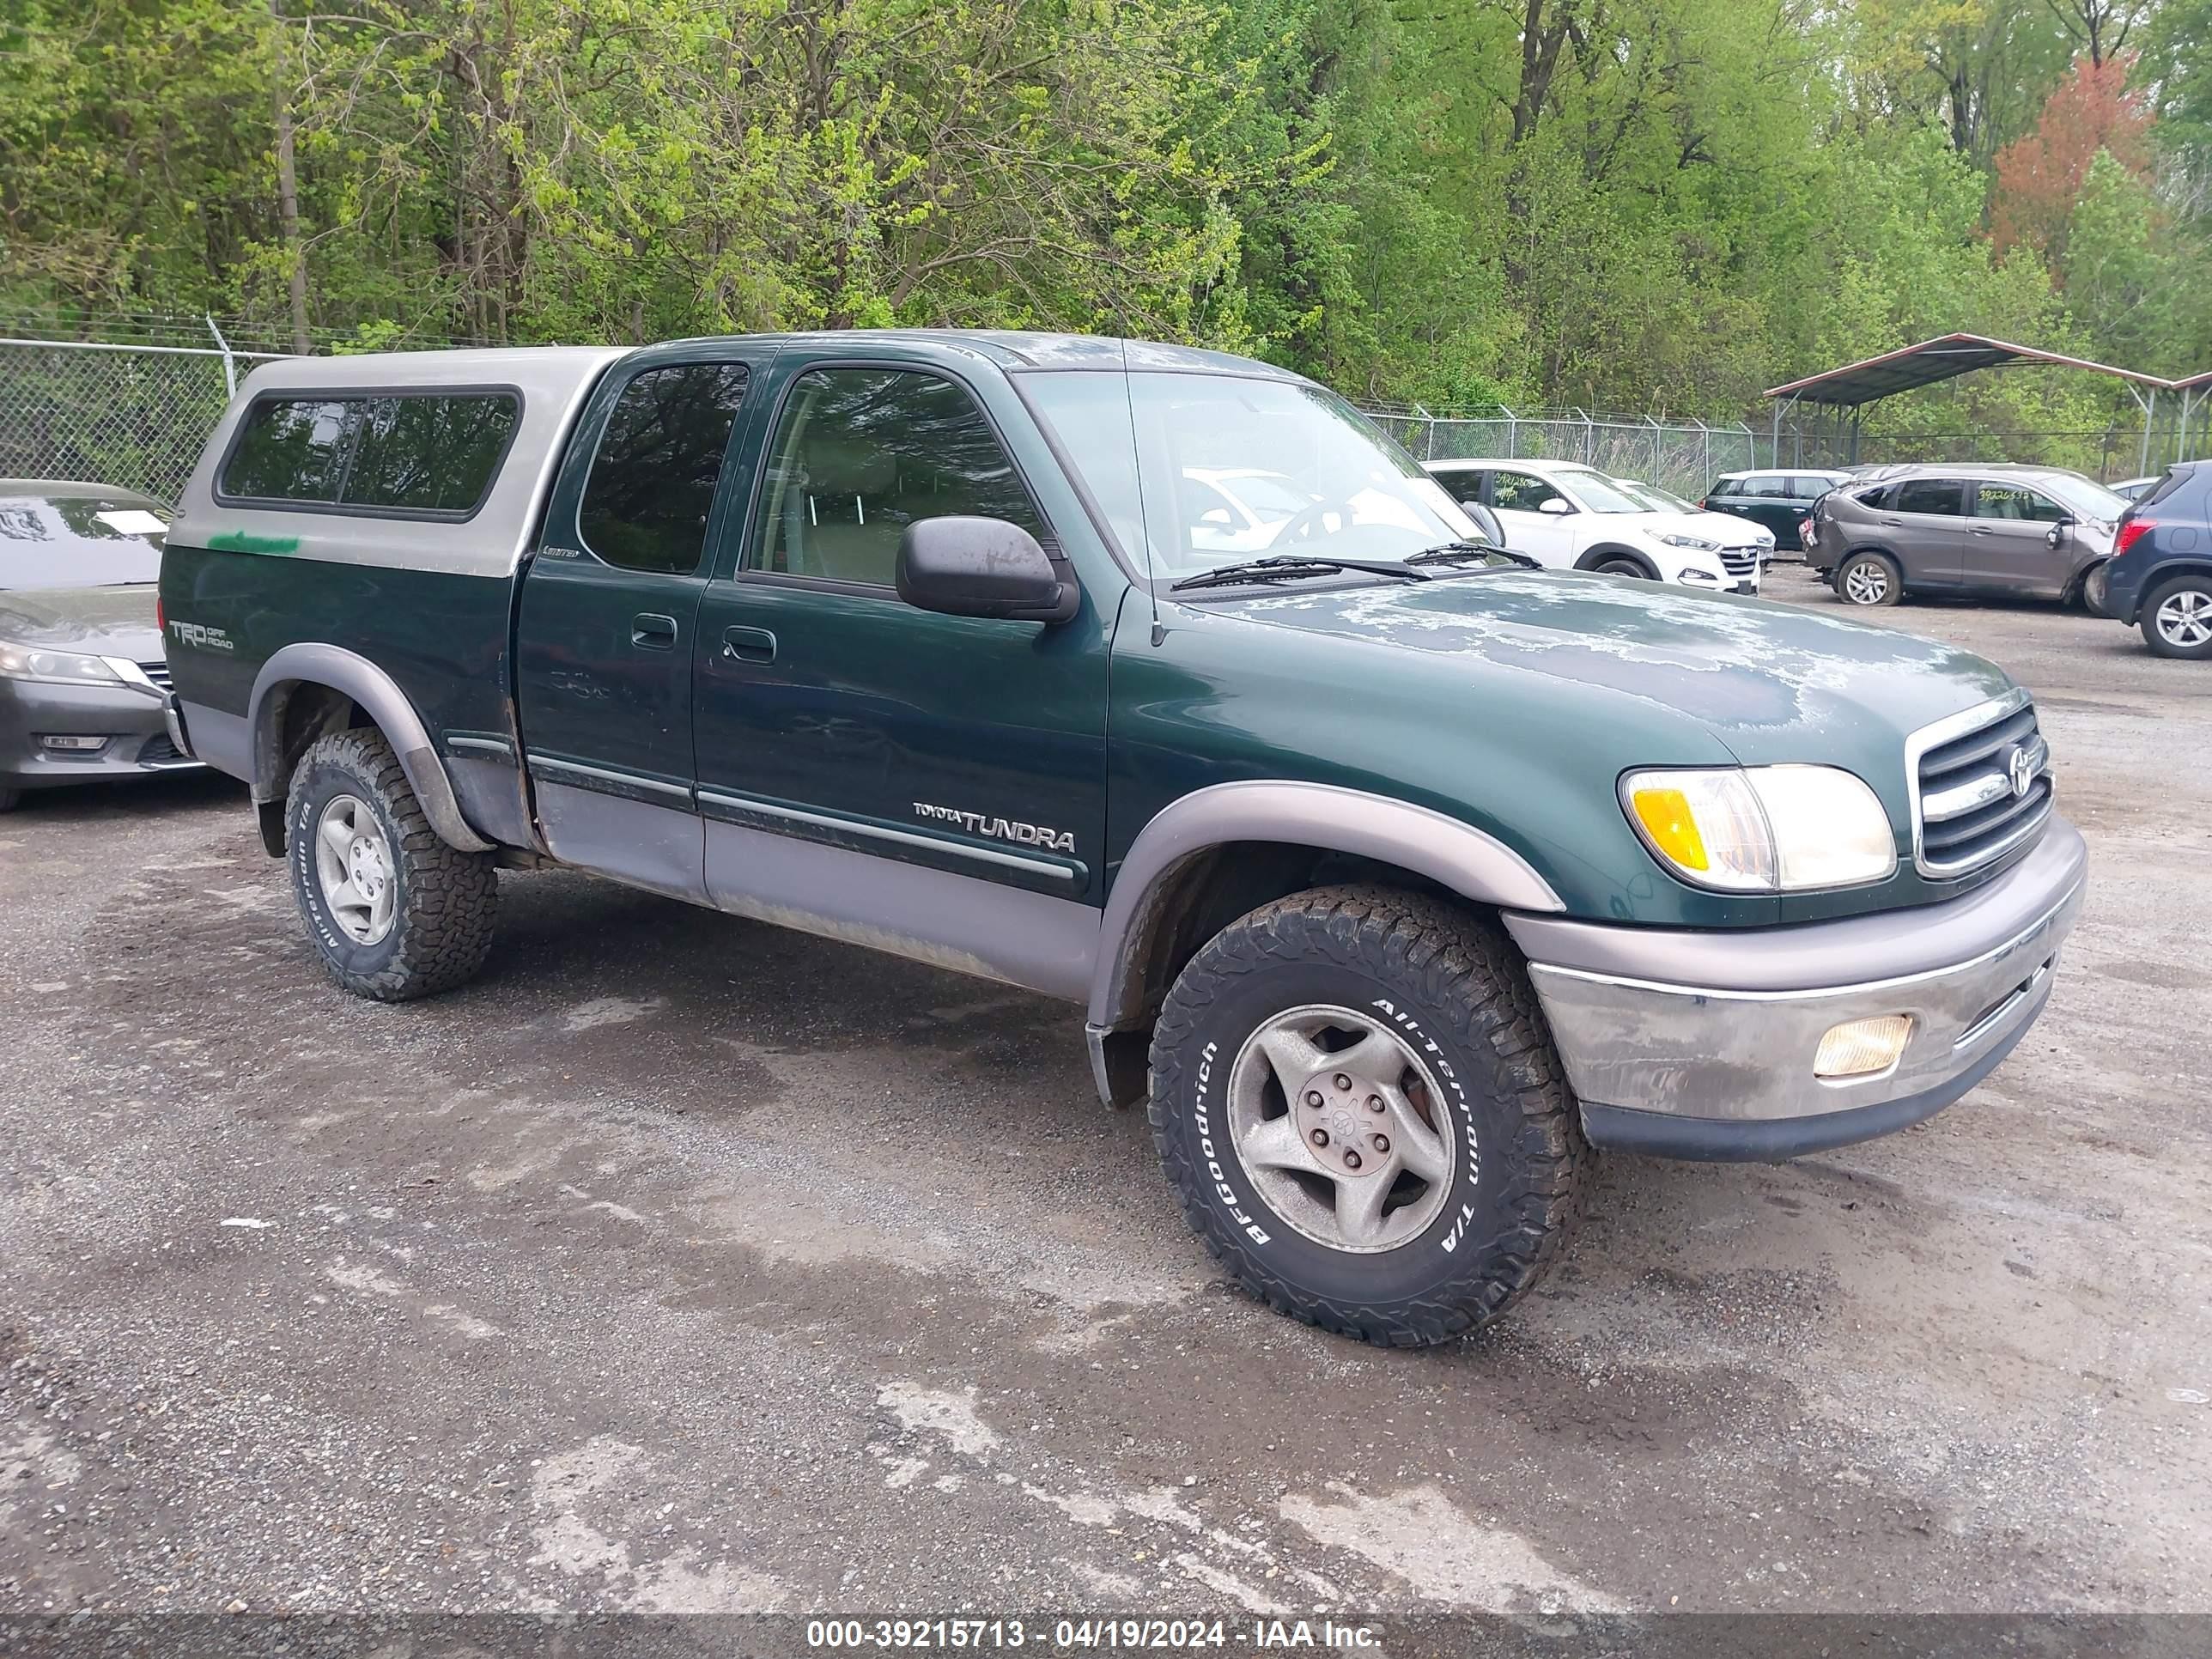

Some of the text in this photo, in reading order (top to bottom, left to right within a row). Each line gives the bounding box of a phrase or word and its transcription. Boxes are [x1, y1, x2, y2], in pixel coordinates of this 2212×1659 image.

[169, 620, 206, 647] TRD
[207, 627, 227, 637] OFF
[207, 637, 234, 649] ROAD
[913, 802, 1076, 854] TOYOTA TUNDRA
[1194, 1042, 1271, 1245] BFGoodrich
[1371, 999, 1482, 1253] All-Terrain T/A
